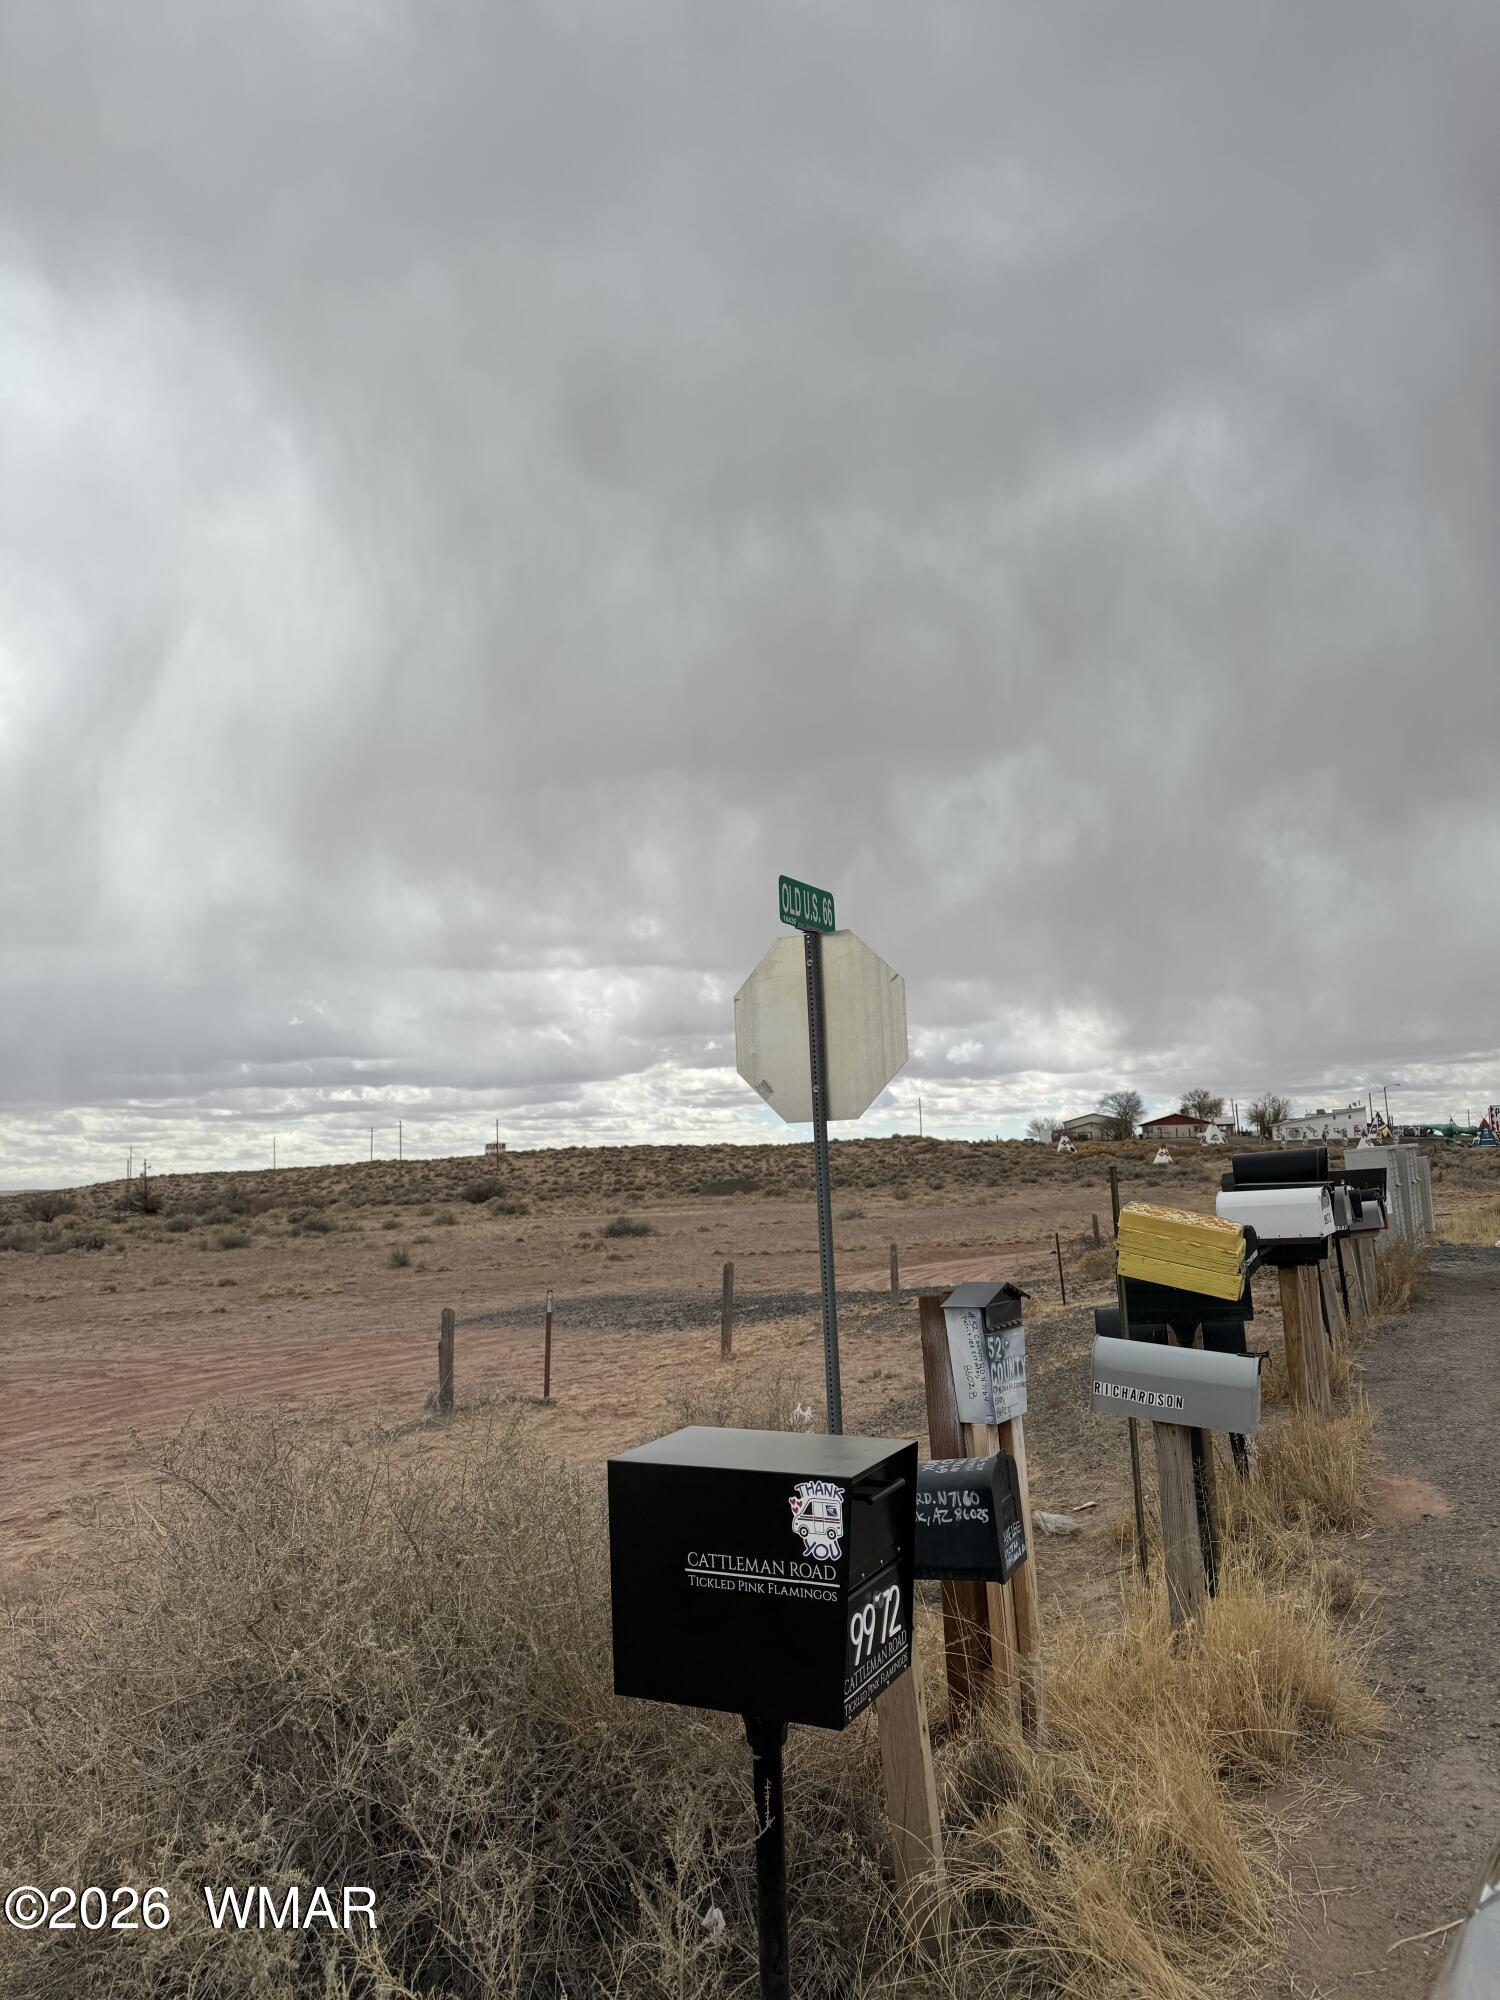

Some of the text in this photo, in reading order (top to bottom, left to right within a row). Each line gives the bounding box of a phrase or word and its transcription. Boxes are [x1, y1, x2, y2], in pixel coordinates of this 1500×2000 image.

[782, 883, 832, 927] OLD U.S. 66
[987, 1336, 1003, 1359] 52
[991, 1356, 1026, 1386] COUNTY
[1094, 1381, 1184, 1409] RICHARDSON
[794, 1480, 845, 1503] THANK
[932, 1507, 953, 1526] AZ
[803, 1538, 843, 1560] YOU
[687, 1551, 837, 1581] CATTLEMAN ROAD
[688, 1574, 838, 1602] TICKLED PINK FLAMINGOS
[850, 1584, 902, 1667] 9972
[844, 1629, 907, 1696] CATTLEMAN ROAD
[844, 1652, 908, 1717] TICKLED PINK FLAMINGOS
